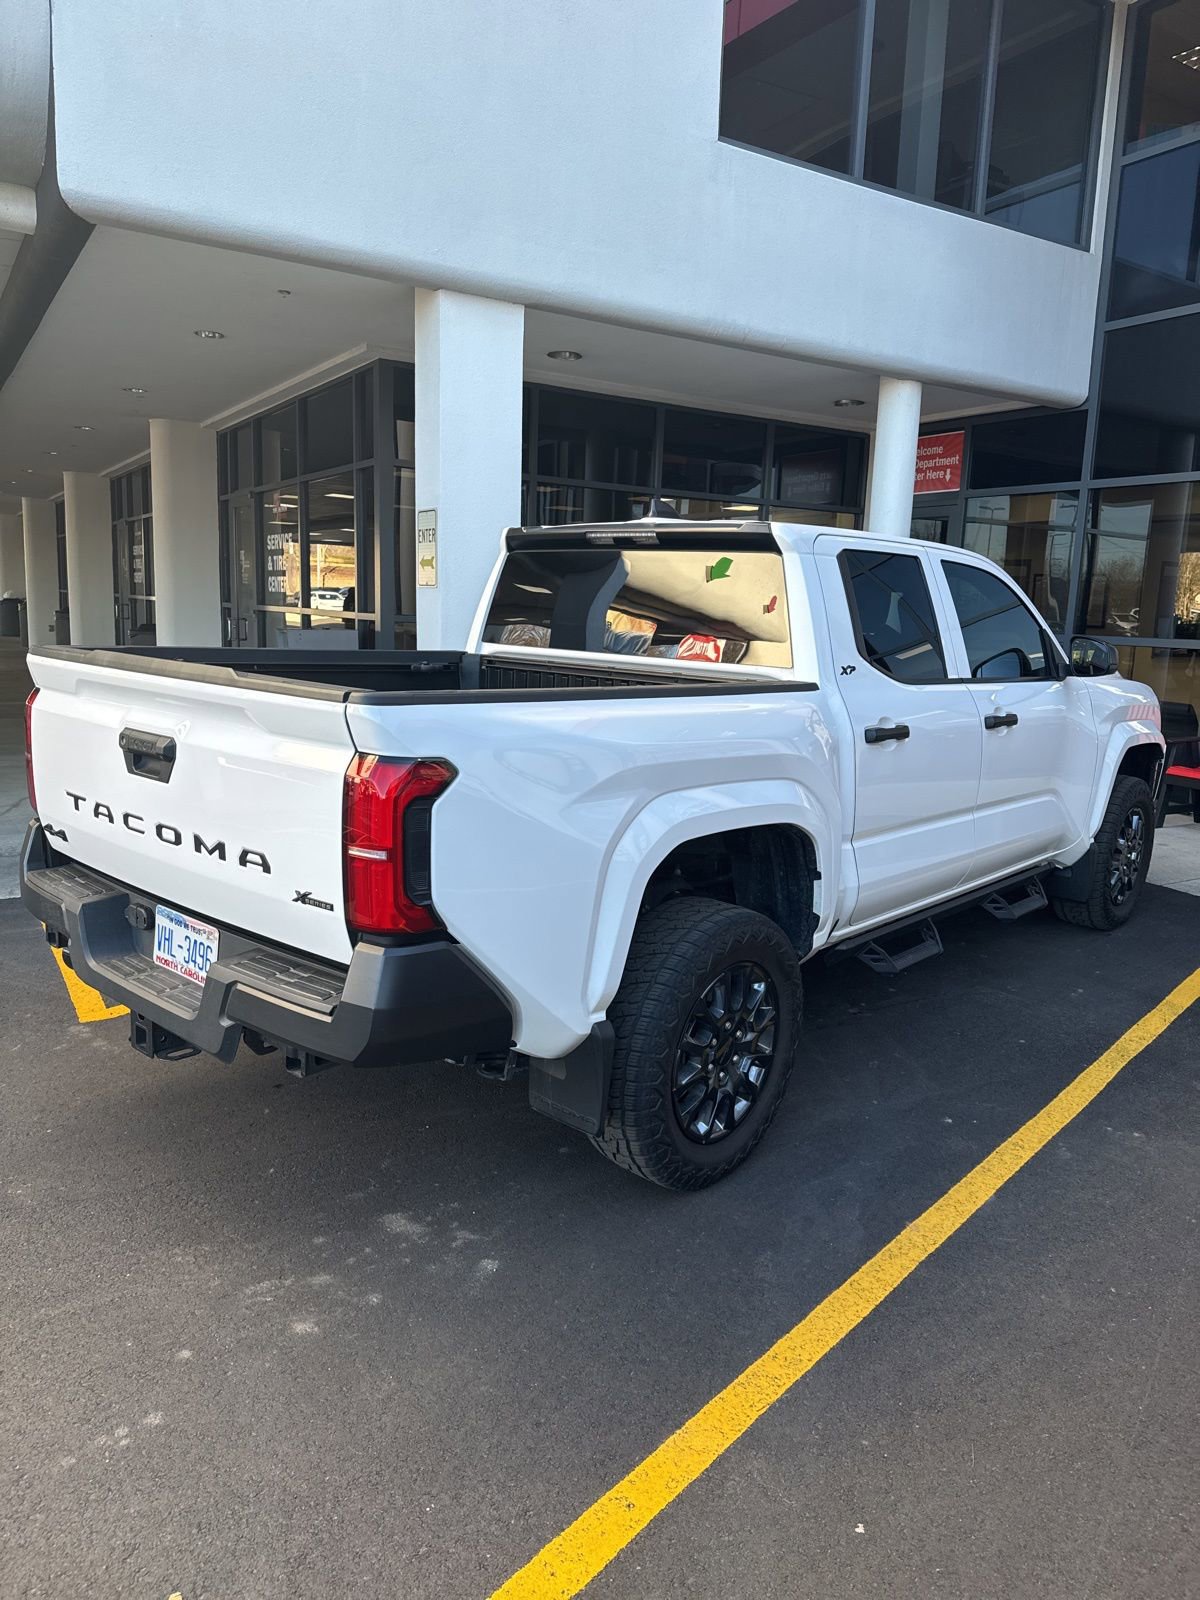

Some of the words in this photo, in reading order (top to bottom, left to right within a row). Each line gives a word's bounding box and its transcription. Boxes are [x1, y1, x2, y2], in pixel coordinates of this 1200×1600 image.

[916, 446, 944, 457] elcome
[926, 470, 945, 480] Here
[267, 533, 293, 550] SERVICE
[418, 528, 436, 543] ENTER
[267, 555, 273, 571] &
[840, 665, 856, 675] XP
[65, 790, 272, 875] TACOMA
[157, 924, 213, 973] VHL-3496
[156, 955, 178, 971] NORTH
